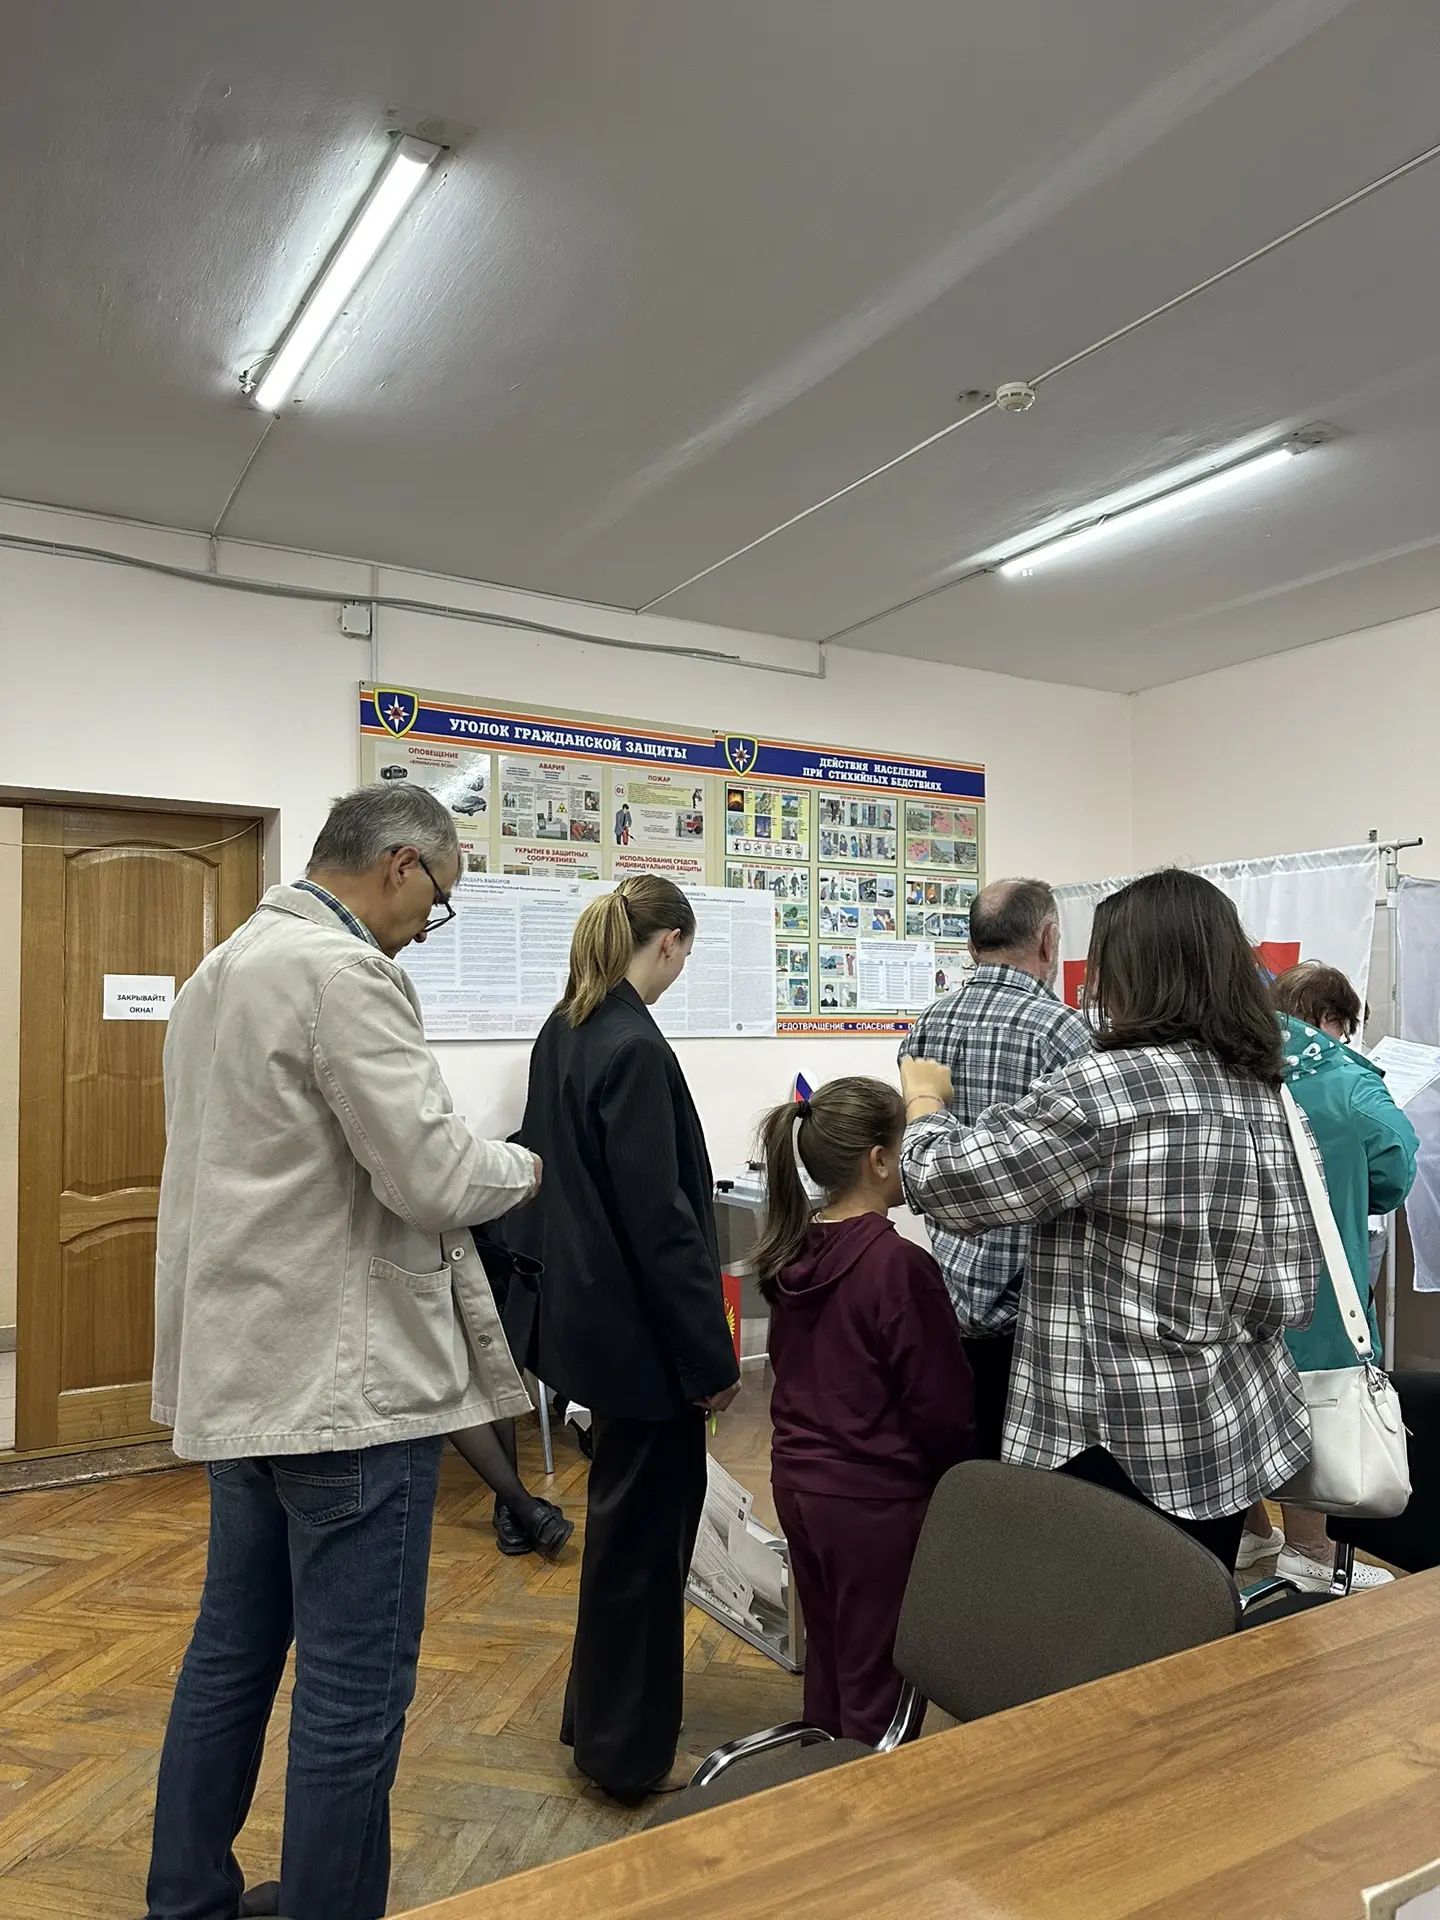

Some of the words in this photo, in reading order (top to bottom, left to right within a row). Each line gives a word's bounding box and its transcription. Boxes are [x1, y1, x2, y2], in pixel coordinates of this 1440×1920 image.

[449, 718, 510, 737] УГОЛОК
[514, 726, 621, 752] ГРАЖДАНСКОЙ
[626, 741, 687, 759] ЗАЩИТЫ
[408, 747, 459, 759] ОПОВЕЩЕНИЕ
[539, 763, 565, 771] АВАРИЯ
[819, 757, 868, 771] ДЕЙСТВИЯ
[874, 764, 928, 779] НАСЕЛЕНИЯ
[648, 774, 671, 783] ПОЖАР
[802, 767, 823, 778] ПРИ
[828, 769, 888, 785] СТИХИЙНЫХ
[891, 778, 942, 791] БЕДСТВИЯХ
[514, 847, 545, 855] УКРЫТИЕ
[551, 849, 589, 858] ЗАЩИТНЫХ
[526, 854, 577, 864] СООРУЖЕНИЯХ
[619, 854, 673, 864] ИСПОЛЬЗОВАНИЕ
[673, 858, 698, 866] СРЕДСТВ
[615, 861, 675, 870] ИНДИВИДУАЛЬНОЙ
[117, 993, 166, 1002] ЗАКРЫВАЙТЕ
[777, 1022, 845, 1031] РЕДОТВРАЩЕНИЕ
[856, 1022, 895, 1031] СПАСЕНИЕ
